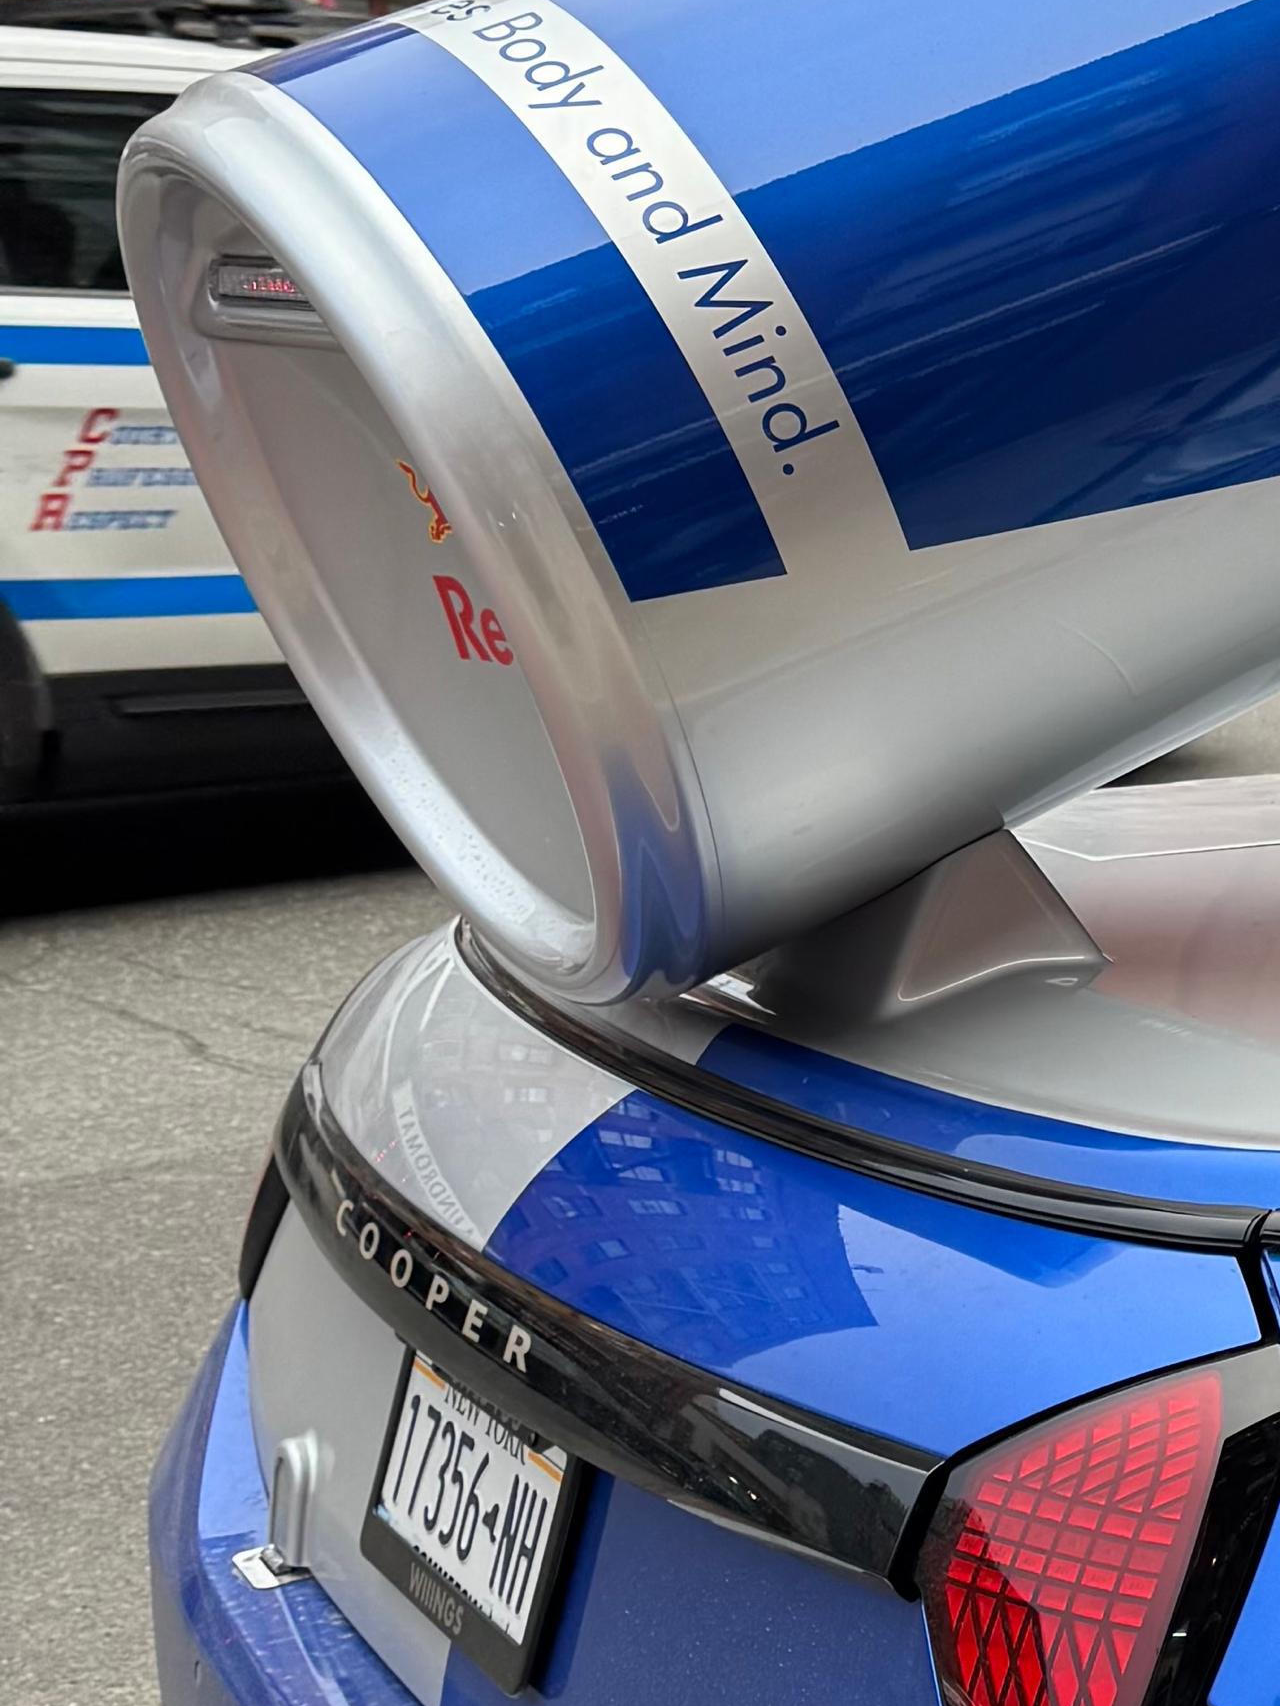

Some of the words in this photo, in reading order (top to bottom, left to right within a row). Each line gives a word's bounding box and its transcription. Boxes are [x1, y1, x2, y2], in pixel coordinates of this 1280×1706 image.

[473, 11, 604, 109] Body
[586, 127, 723, 244] and
[677, 259, 840, 476] Mind.
[337, 1200, 532, 1374] COOPER
[444, 1380, 482, 1426] NEW
[484, 1404, 529, 1465] YORK
